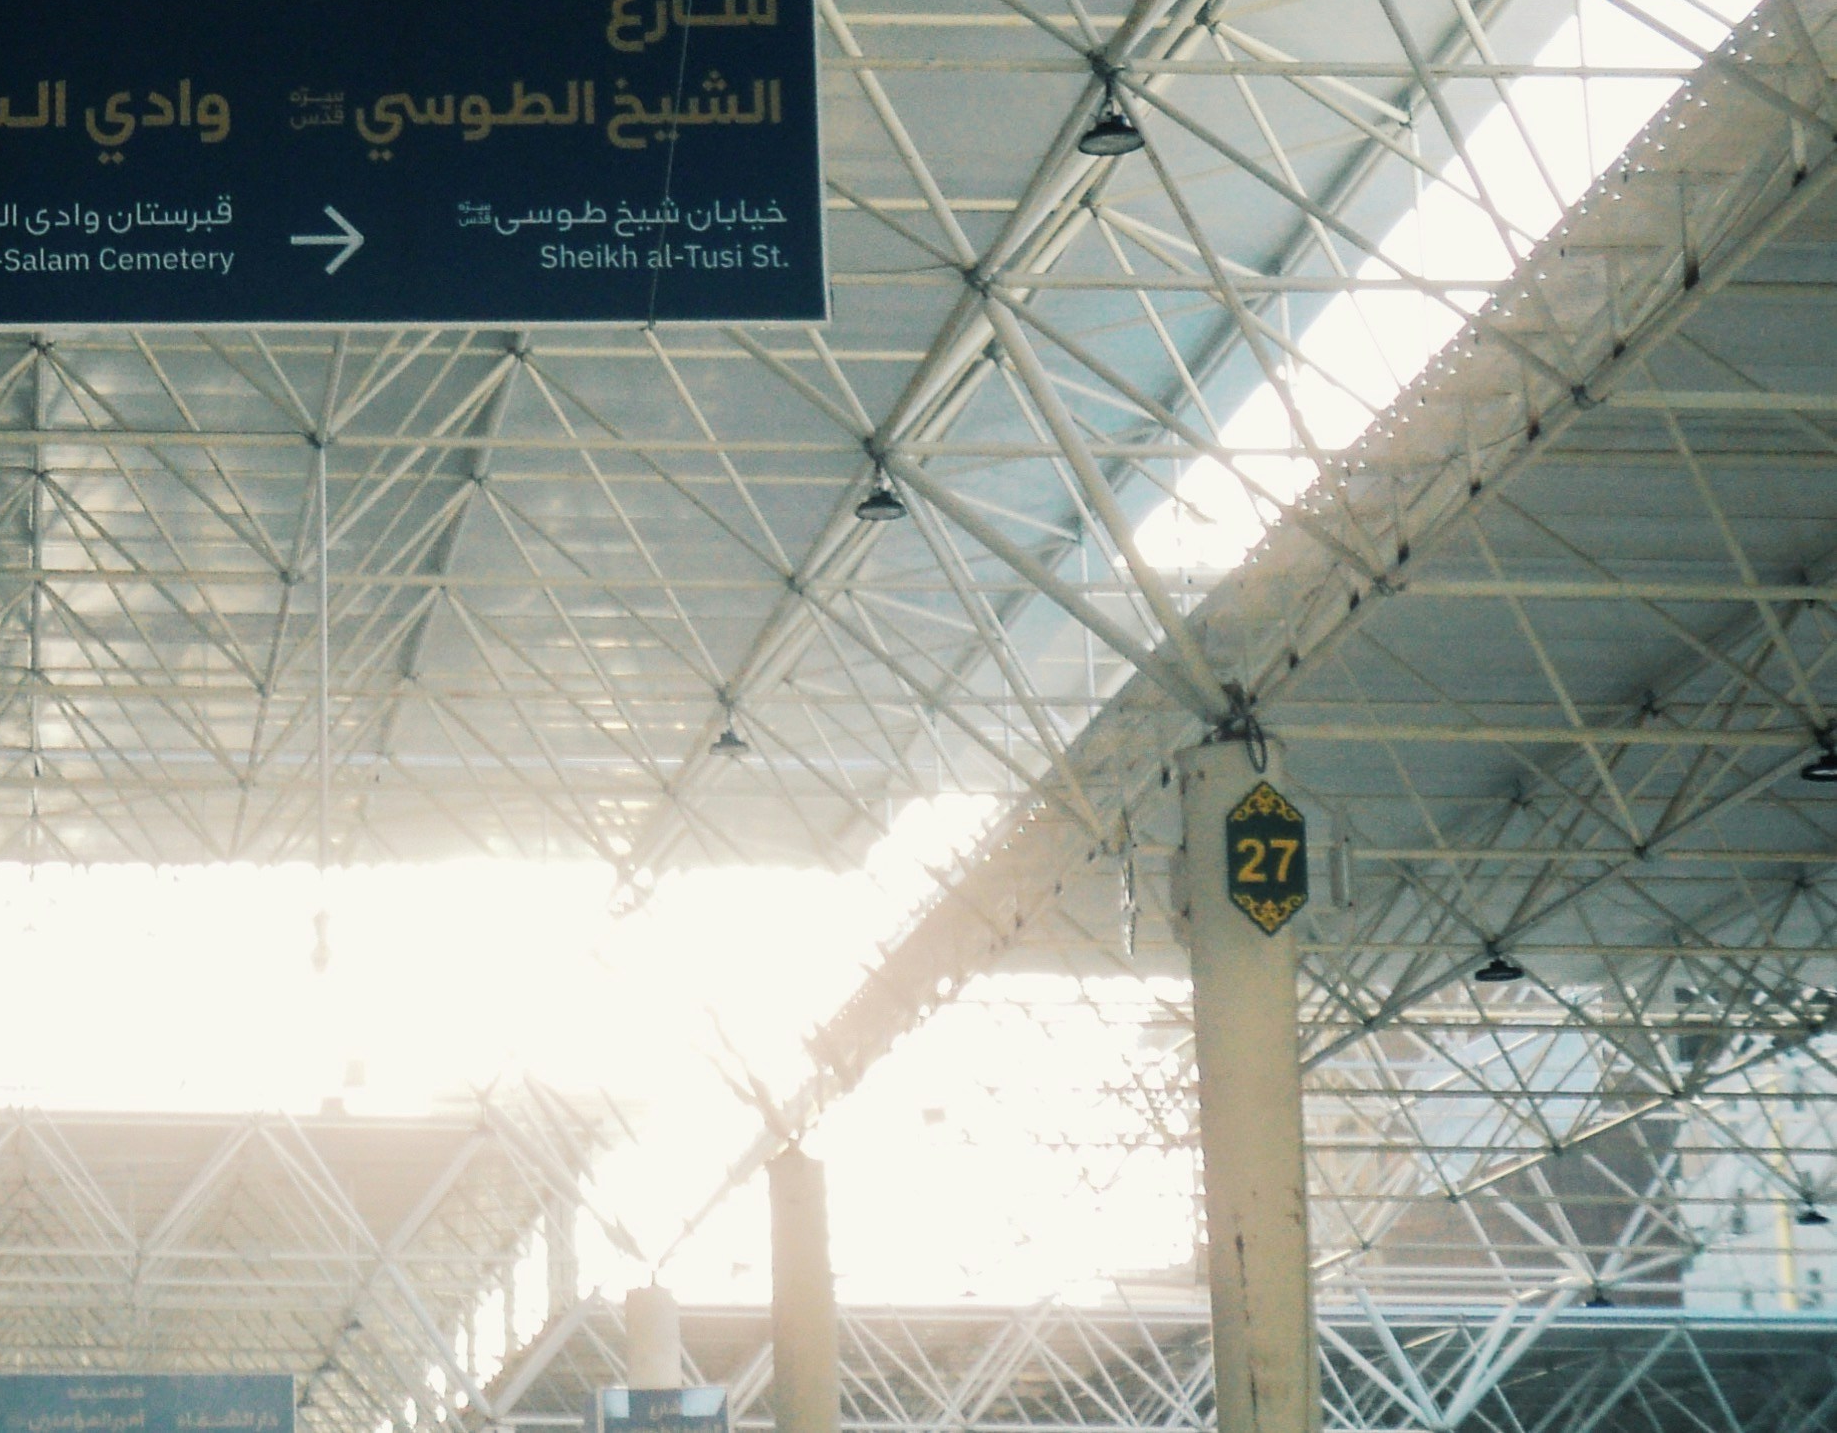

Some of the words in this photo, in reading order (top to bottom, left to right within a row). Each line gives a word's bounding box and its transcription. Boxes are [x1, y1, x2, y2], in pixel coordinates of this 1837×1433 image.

[85, 78, 231, 164] وادي
[355, 80, 595, 161] الطوسي
[606, 71, 782, 149] الشيخ
[107, 195, 233, 234] قبرستان
[99, 247, 235, 275] Cemetery
[540, 244, 638, 269] Sheikh
[647, 243, 742, 269] al-Tusi
[753, 244, 789, 269] St.
[1237, 838, 1298, 882] 27
